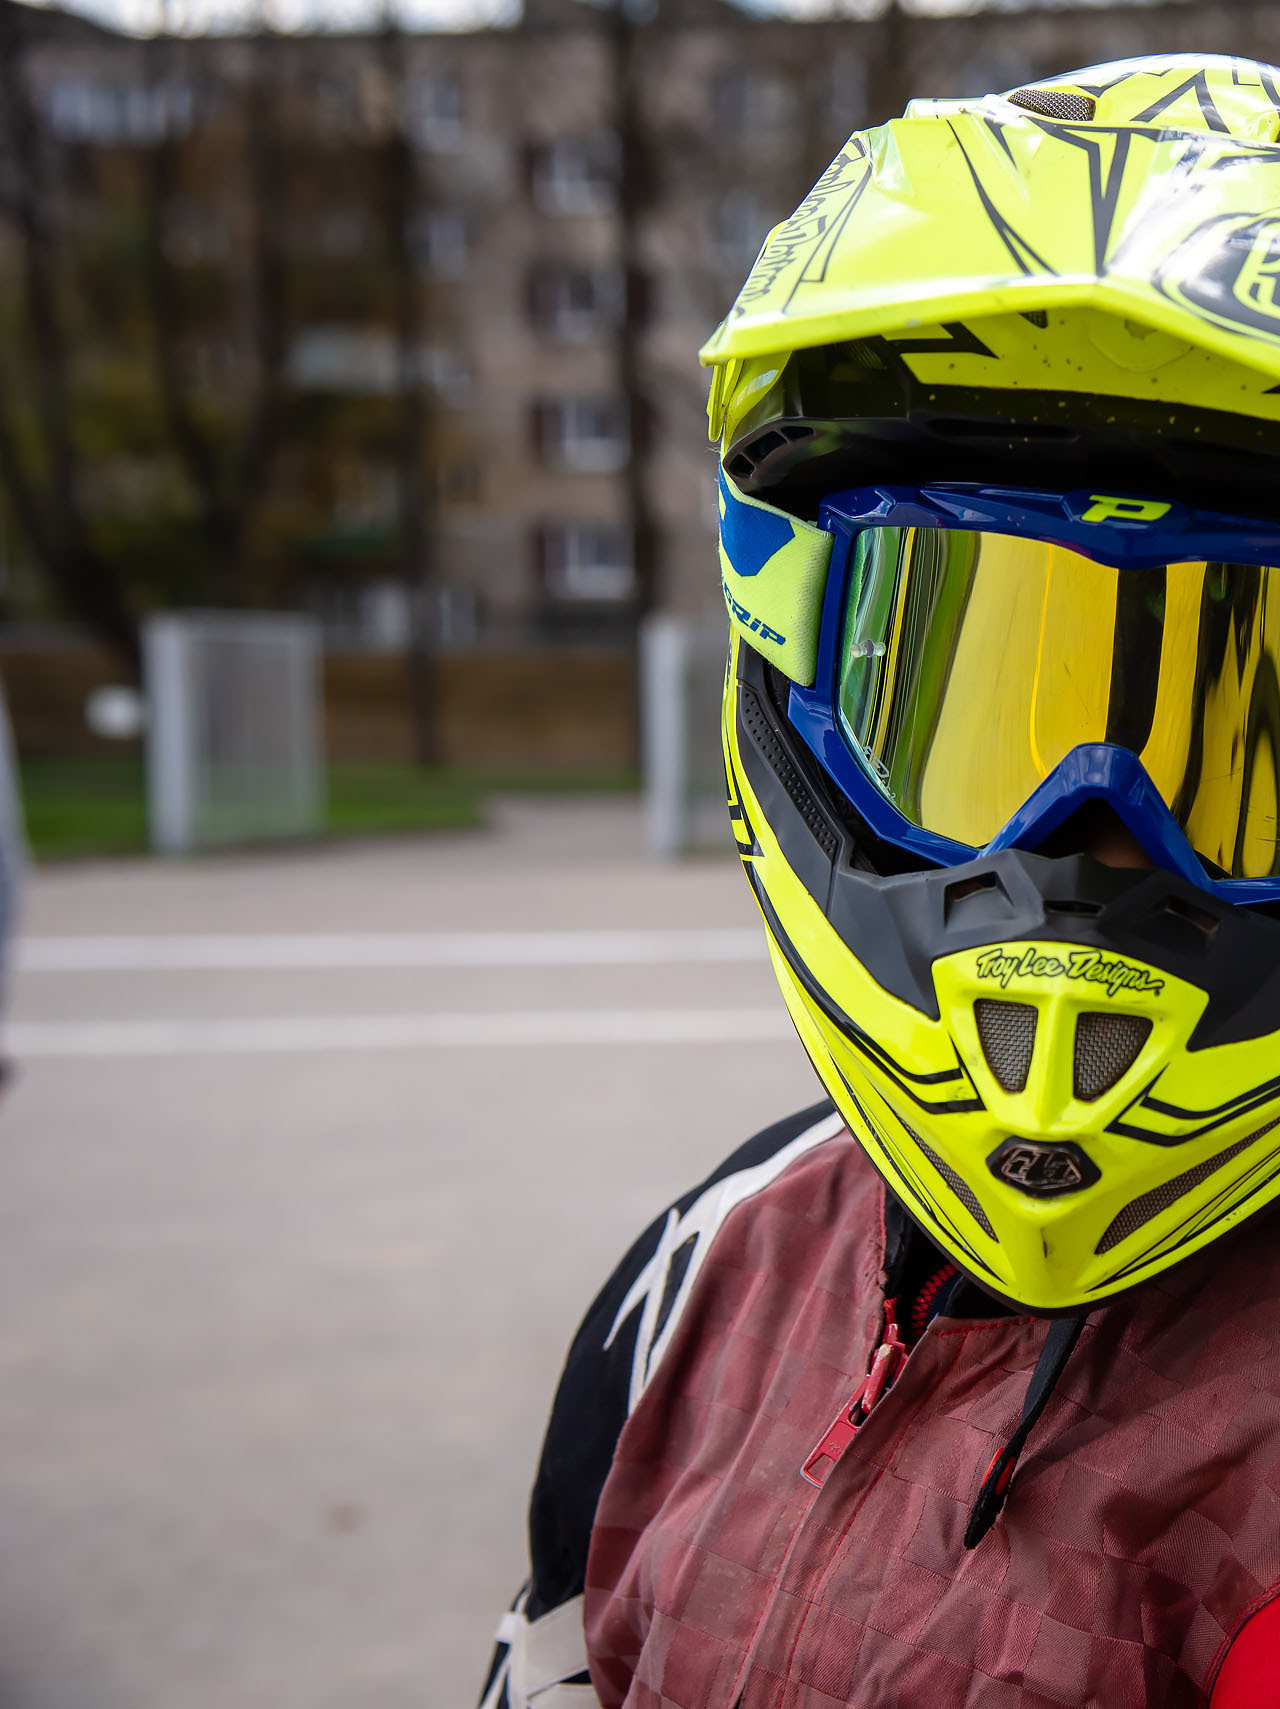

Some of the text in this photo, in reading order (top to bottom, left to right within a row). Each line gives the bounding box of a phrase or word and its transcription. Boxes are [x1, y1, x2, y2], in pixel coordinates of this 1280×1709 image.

[976, 947, 1166, 997] Troy Lee Designs
